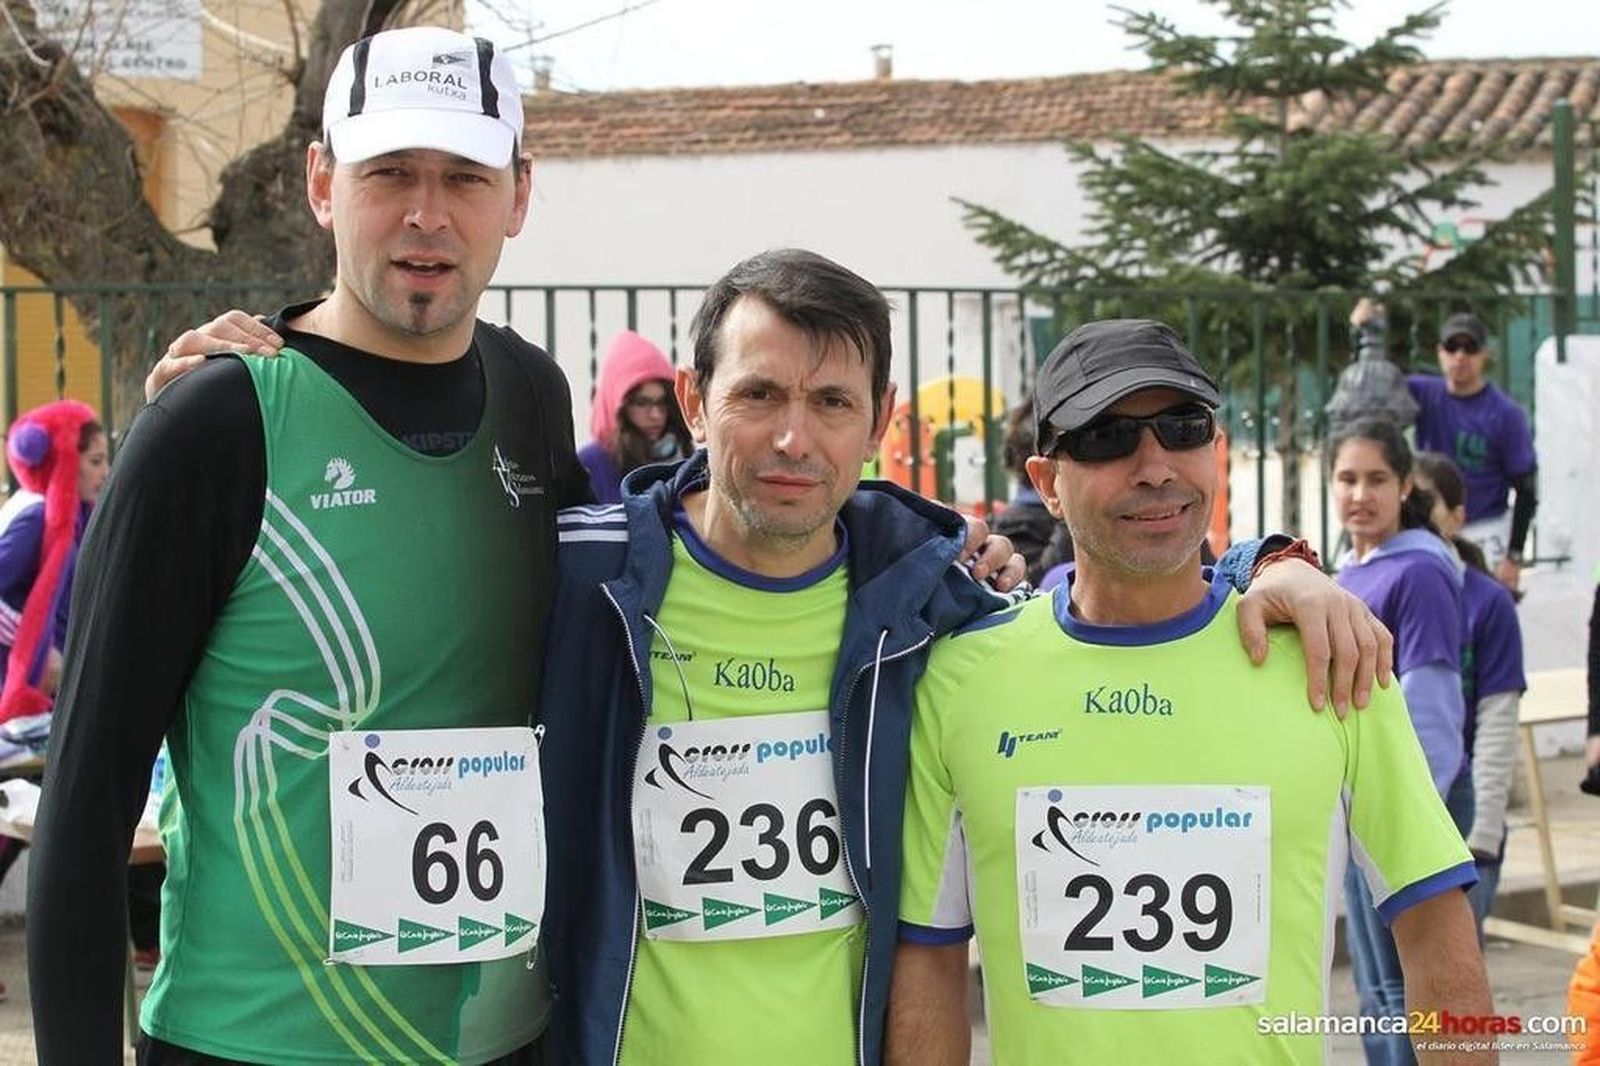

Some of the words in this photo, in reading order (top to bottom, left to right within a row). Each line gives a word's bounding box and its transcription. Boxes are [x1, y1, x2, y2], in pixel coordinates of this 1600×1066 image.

[374, 70, 468, 90] LABORAL
[427, 84, 467, 101] kutxa
[310, 488, 377, 510] VIATOR
[458, 750, 526, 779] popular
[684, 744, 750, 763] cross
[1073, 812, 1141, 828] cross
[1147, 807, 1252, 833] popular
[680, 799, 840, 885] 236
[412, 820, 504, 905] 66
[1063, 873, 1233, 951] 239
